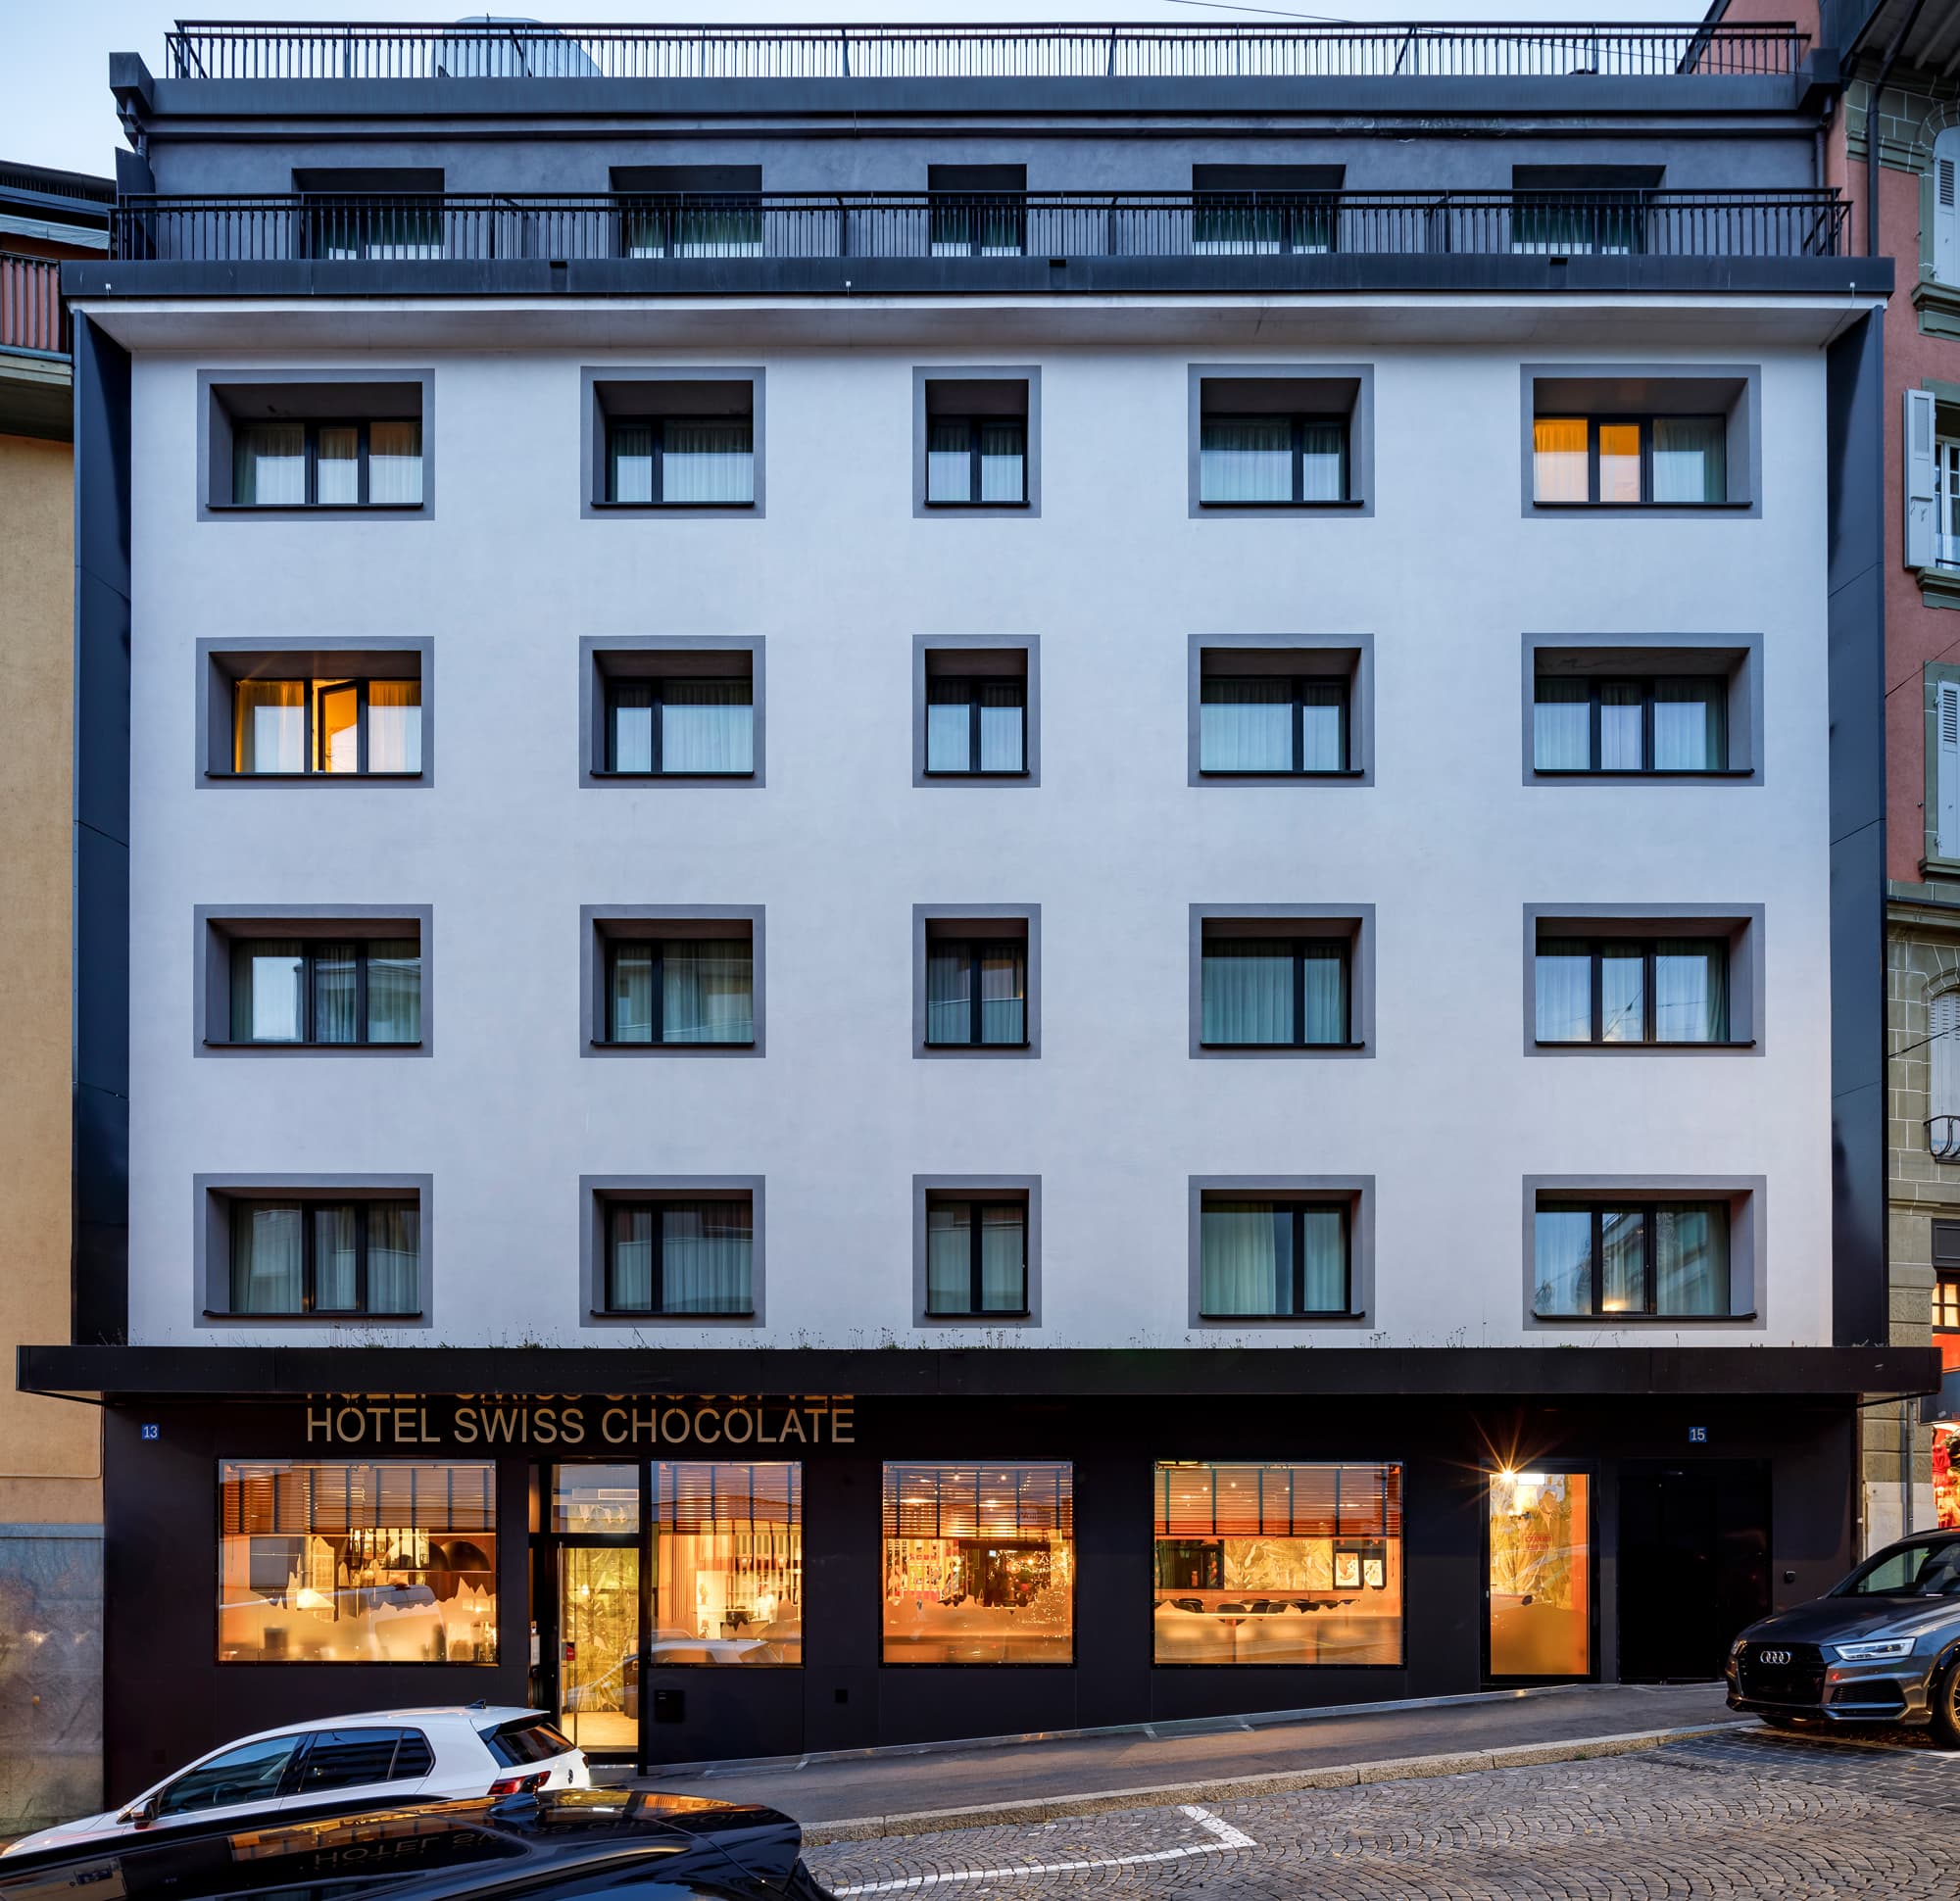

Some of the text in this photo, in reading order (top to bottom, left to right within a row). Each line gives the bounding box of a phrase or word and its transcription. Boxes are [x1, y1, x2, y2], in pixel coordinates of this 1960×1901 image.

[307, 1406, 856, 1443] HOTEL SWISS CHOCOLATE
[143, 1426, 158, 1438] 13
[1690, 1428, 1705, 1441] 15
